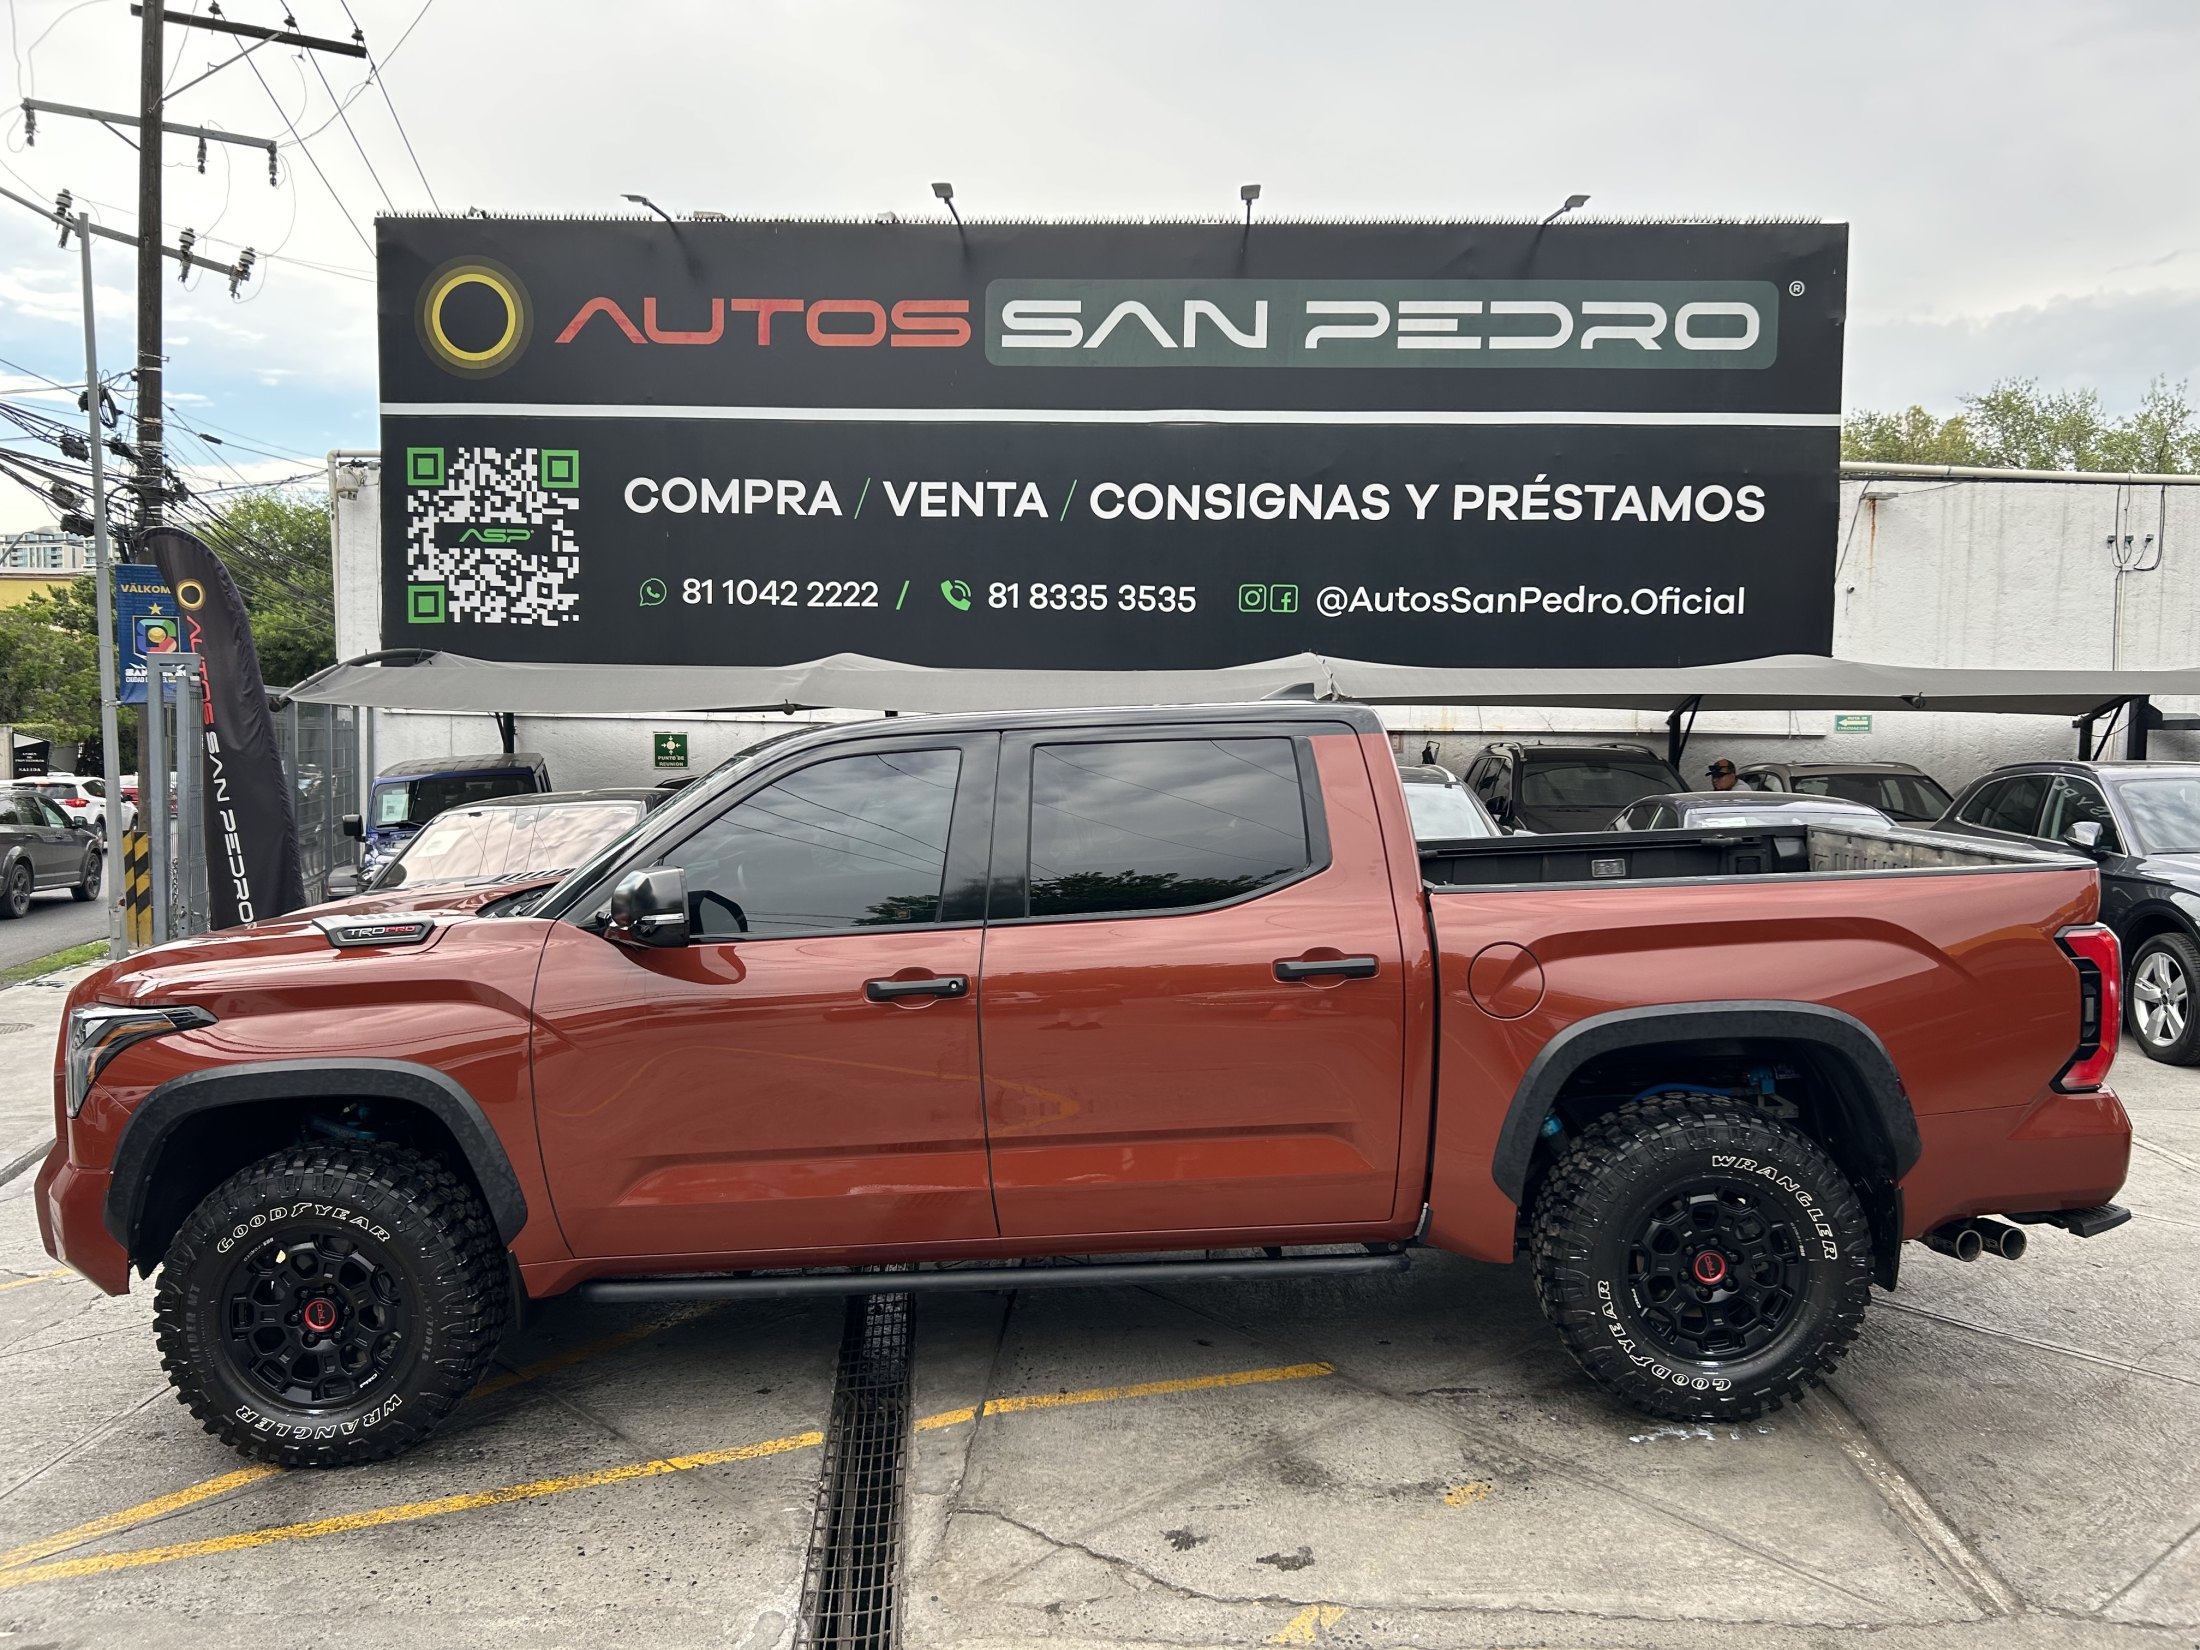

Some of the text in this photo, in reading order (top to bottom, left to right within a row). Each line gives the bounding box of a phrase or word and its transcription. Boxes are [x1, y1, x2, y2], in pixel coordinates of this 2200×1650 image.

[555, 297, 972, 348] AUTOS
[1002, 300, 1268, 349] SAN
[1305, 300, 1760, 351] PEDRO
[624, 477, 843, 517] COMPRA
[882, 481, 1049, 518] VENTA
[1089, 482, 1390, 521] CONSIGNAS
[1404, 483, 1440, 520] Y
[1453, 473, 1766, 523] PRÉSTAMOS
[459, 528, 531, 543] ASP
[682, 577, 713, 605] 81
[722, 579, 798, 607] 1042
[806, 581, 879, 607] 2222
[988, 582, 1197, 613] 81 8335 3535
[1316, 585, 1745, 618] @AutosSanPedro.Oficial
[206, 731, 230, 802] SAN
[219, 809, 255, 923] PEDRO
[346, 927, 386, 937] TRD
[216, 1202, 391, 1254] GOODYEAR
[1711, 1155, 1838, 1260] WRANGLER
[1597, 1280, 1732, 1392] GOODYEAR
[235, 1394, 403, 1441] WRANGLER
